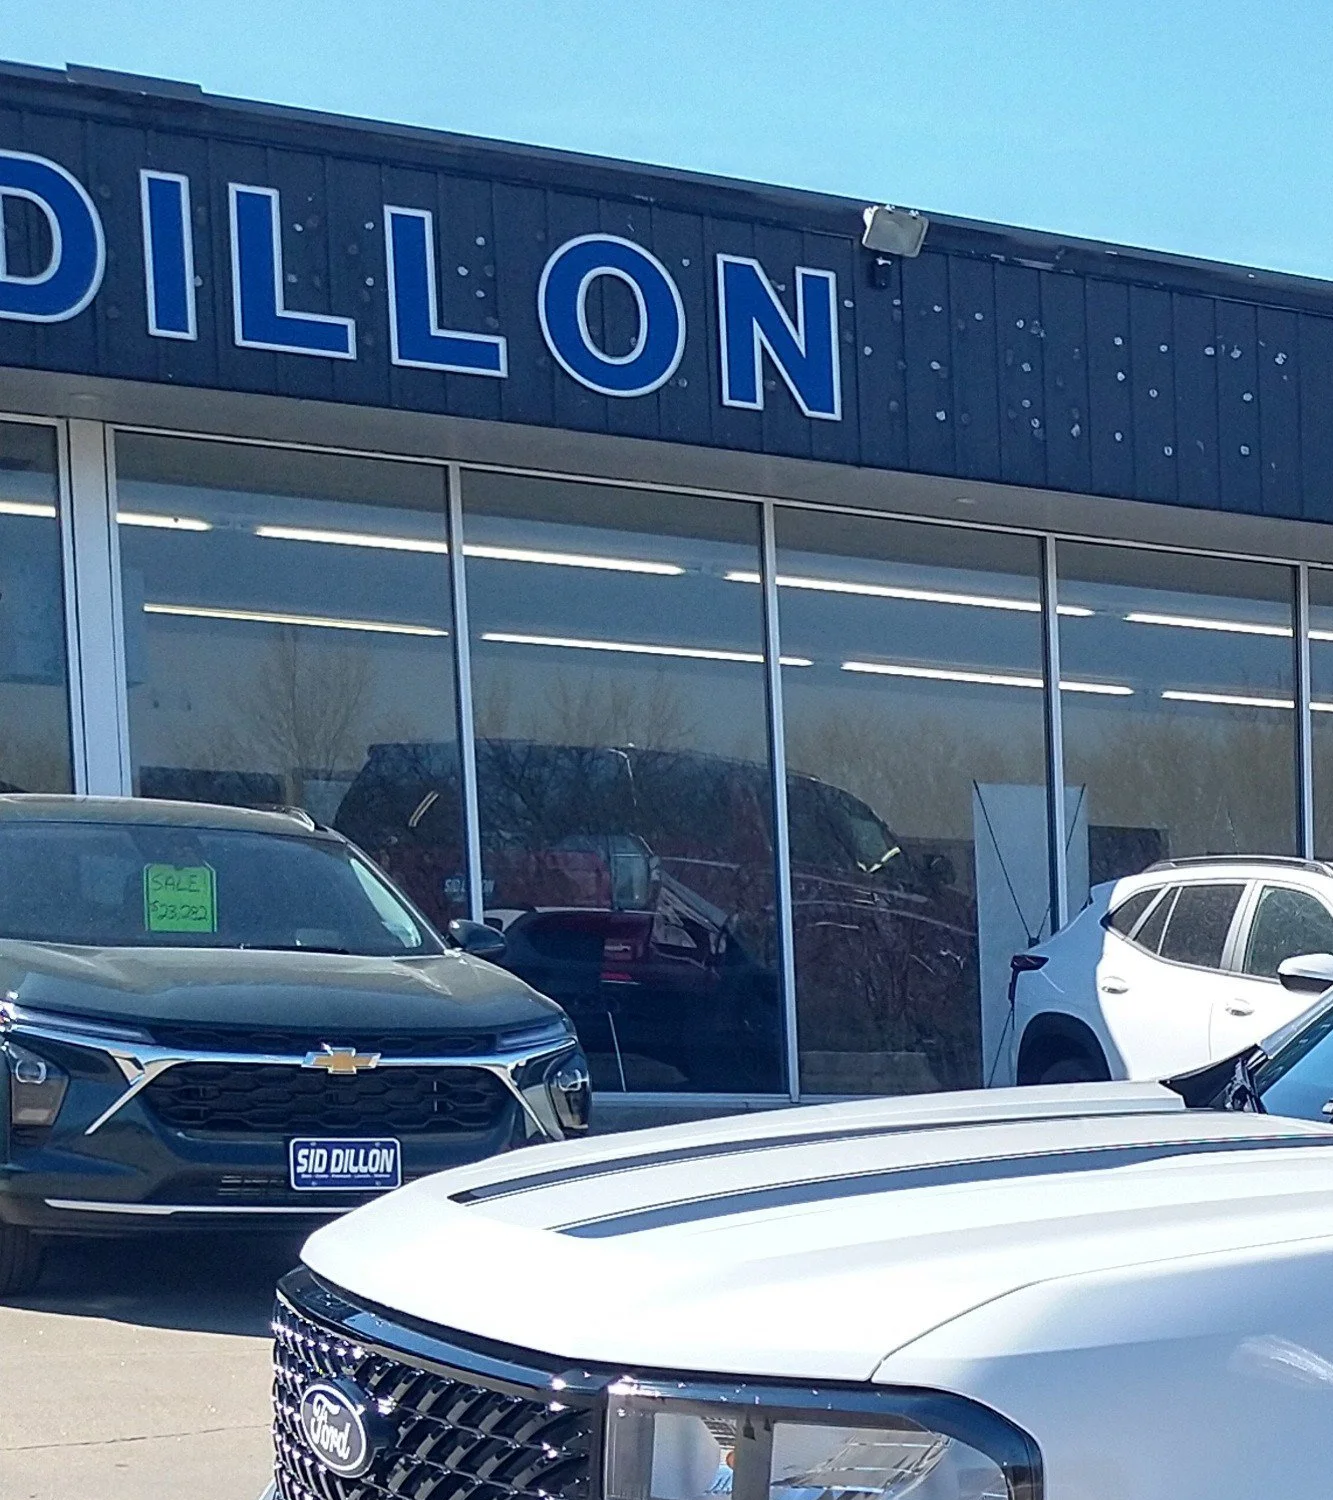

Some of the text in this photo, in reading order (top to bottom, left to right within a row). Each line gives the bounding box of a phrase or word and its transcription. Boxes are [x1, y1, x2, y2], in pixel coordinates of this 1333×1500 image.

[0, 149, 843, 422] DILLON
[296, 1148, 396, 1174] SID DILLON
[310, 1392, 352, 1460] Ford
